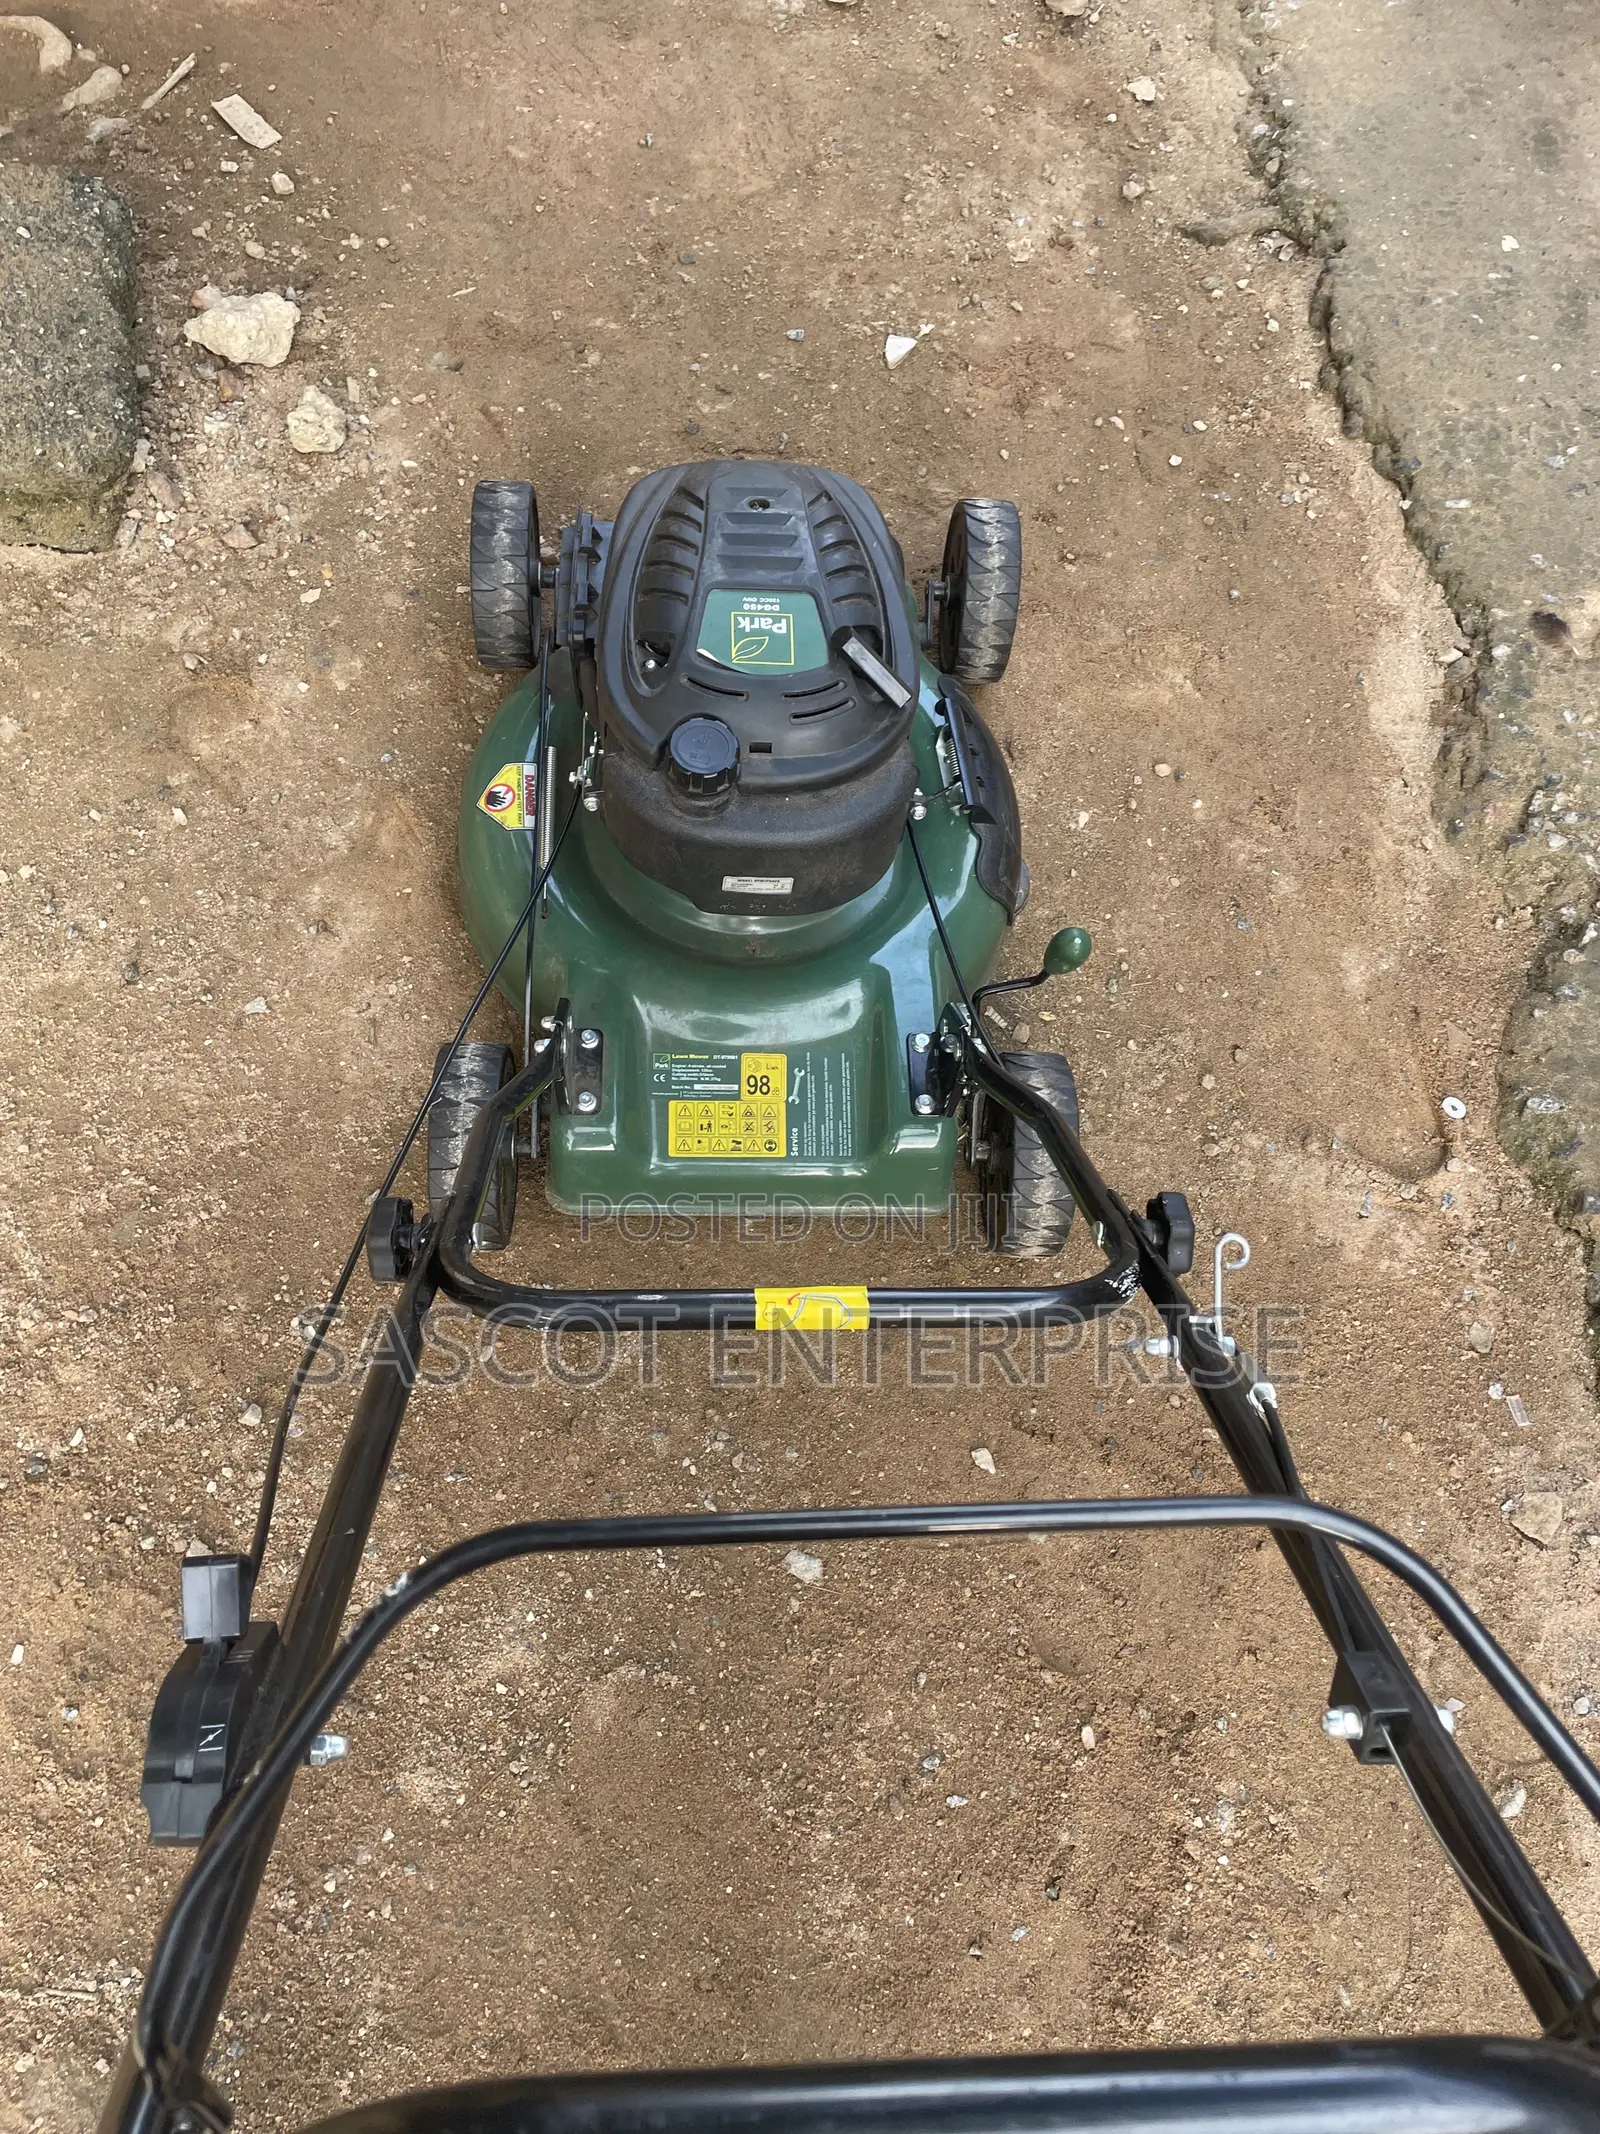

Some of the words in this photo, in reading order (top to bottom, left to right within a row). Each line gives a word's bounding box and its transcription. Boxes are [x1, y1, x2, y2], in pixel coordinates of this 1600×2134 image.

[737, 616, 787, 634] Park
[525, 775, 536, 816] DANGER
[653, 1074, 666, 1082] CE
[746, 1074, 770, 1095] 98
[790, 1127, 799, 1157] Service
